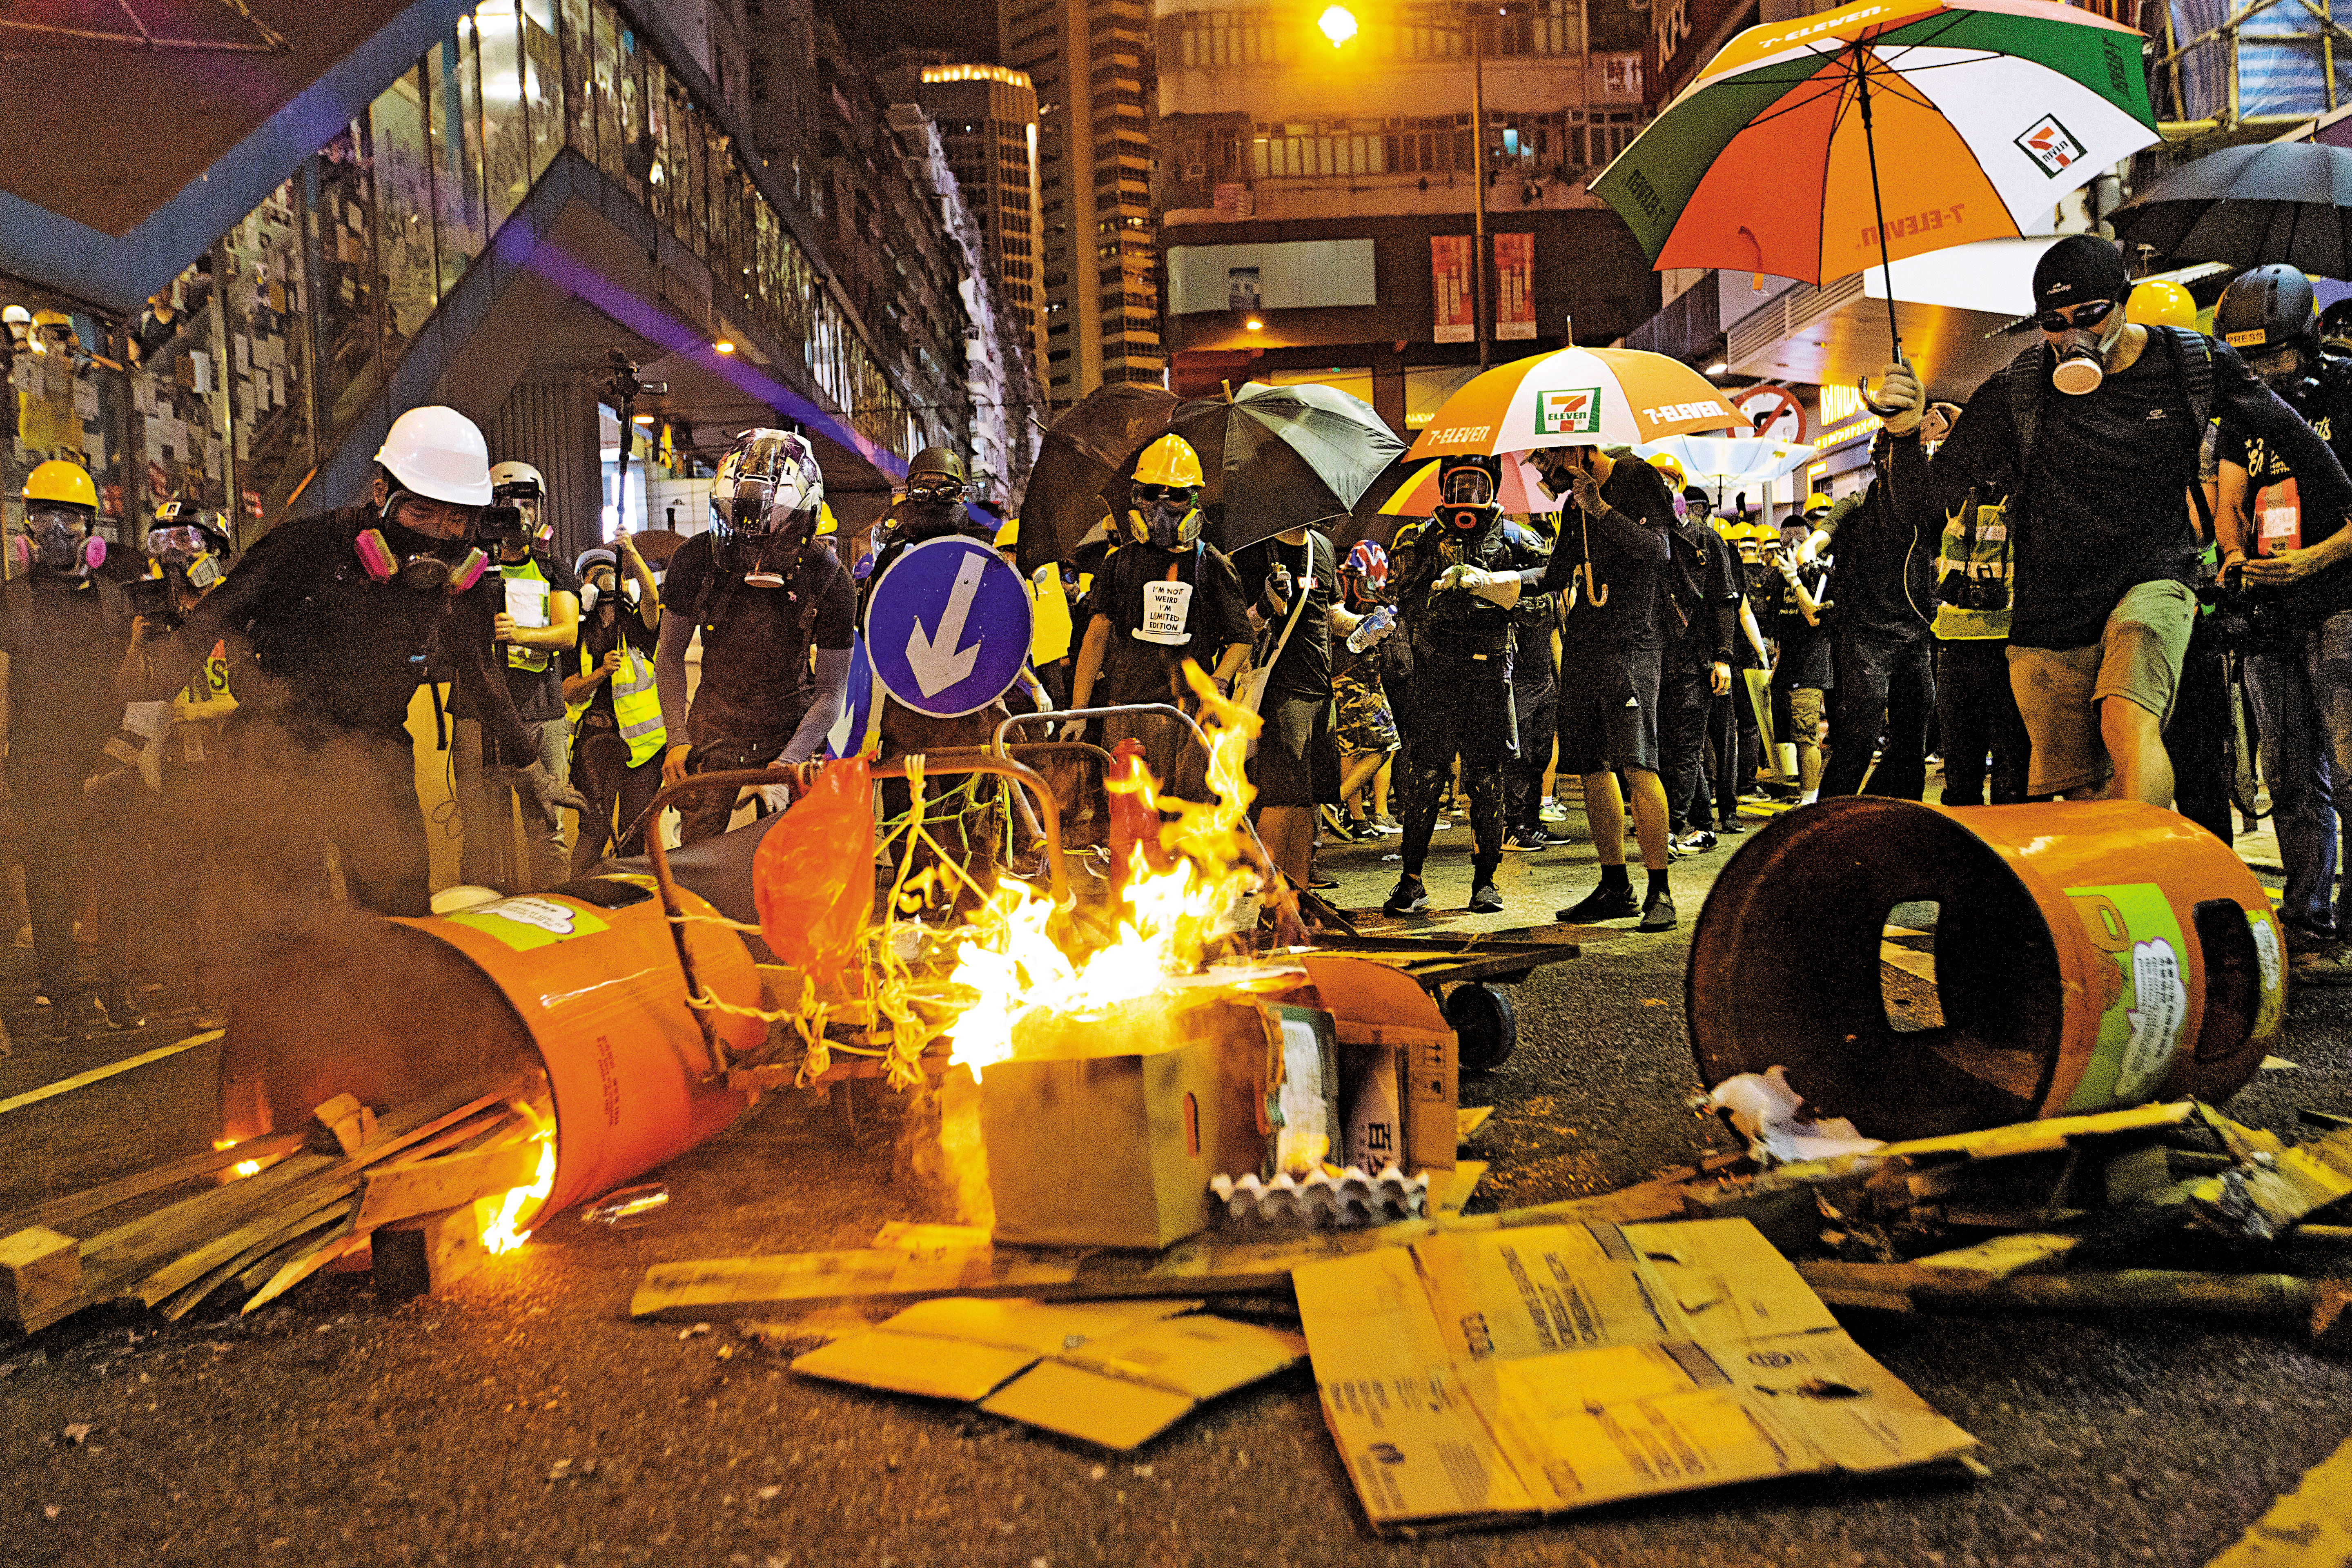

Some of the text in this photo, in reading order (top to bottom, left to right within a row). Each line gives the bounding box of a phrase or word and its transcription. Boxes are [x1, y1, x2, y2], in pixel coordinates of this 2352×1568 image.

[2227, 332, 2263, 343] PRESS
[1154, 595, 1178, 604] WEIRD
[1149, 621, 1178, 631] EDITION
